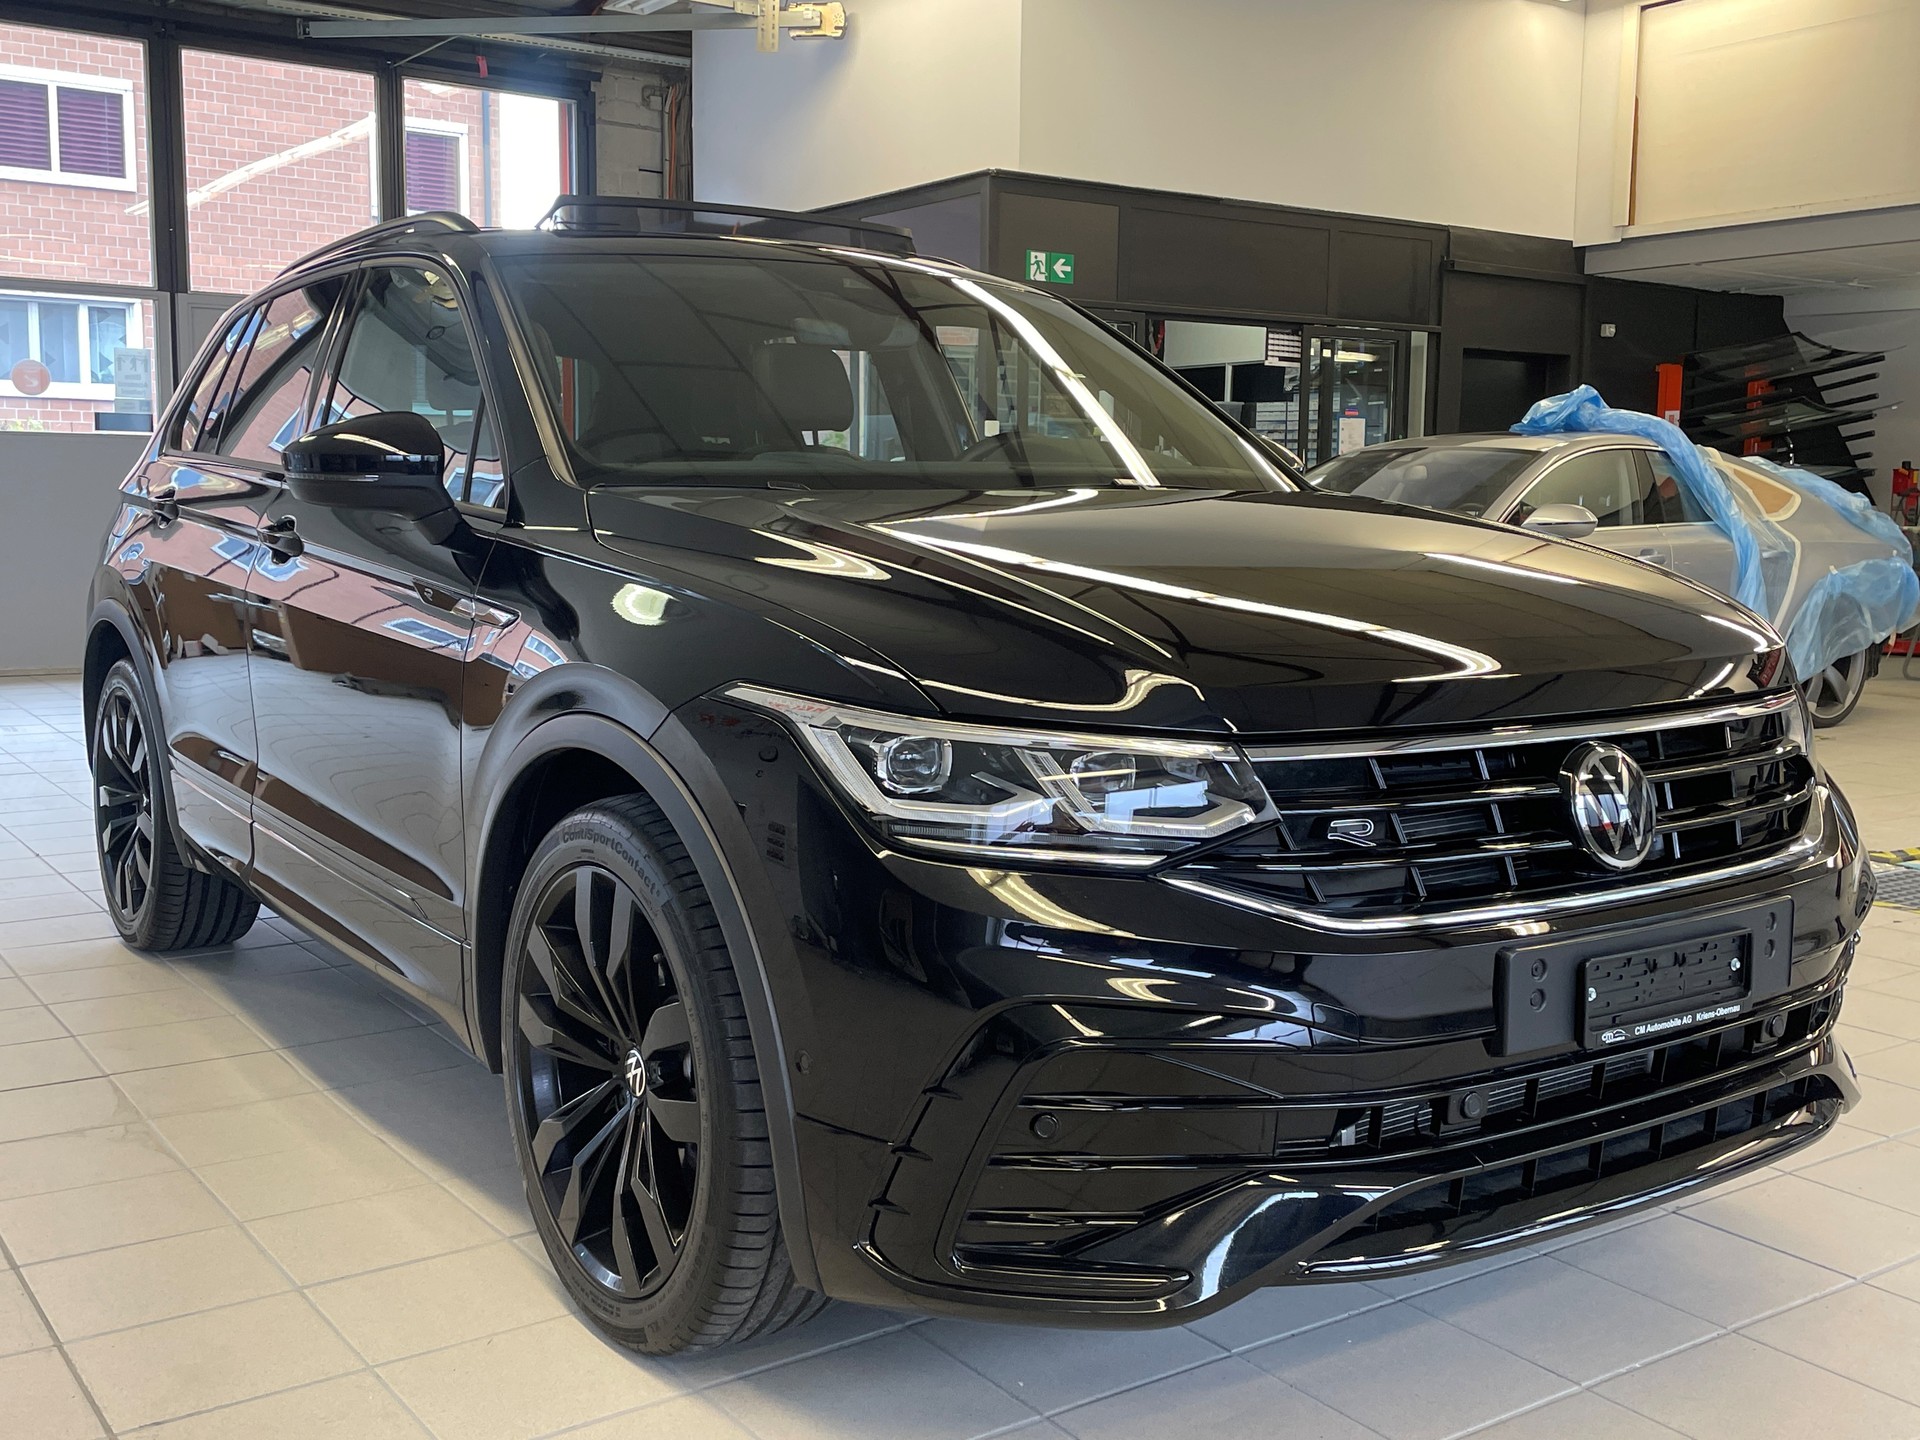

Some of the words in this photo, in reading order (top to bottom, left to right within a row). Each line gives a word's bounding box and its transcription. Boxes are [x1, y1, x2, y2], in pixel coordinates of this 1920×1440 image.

[1327, 818, 1377, 847] R
[562, 827, 657, 896] ContiSportContact
[1634, 1026, 1646, 1036] CM
[1646, 1018, 1682, 1033] Automobile
[1682, 1014, 1693, 1026] AG
[1696, 1004, 1741, 1022] Kriens-Obernau
